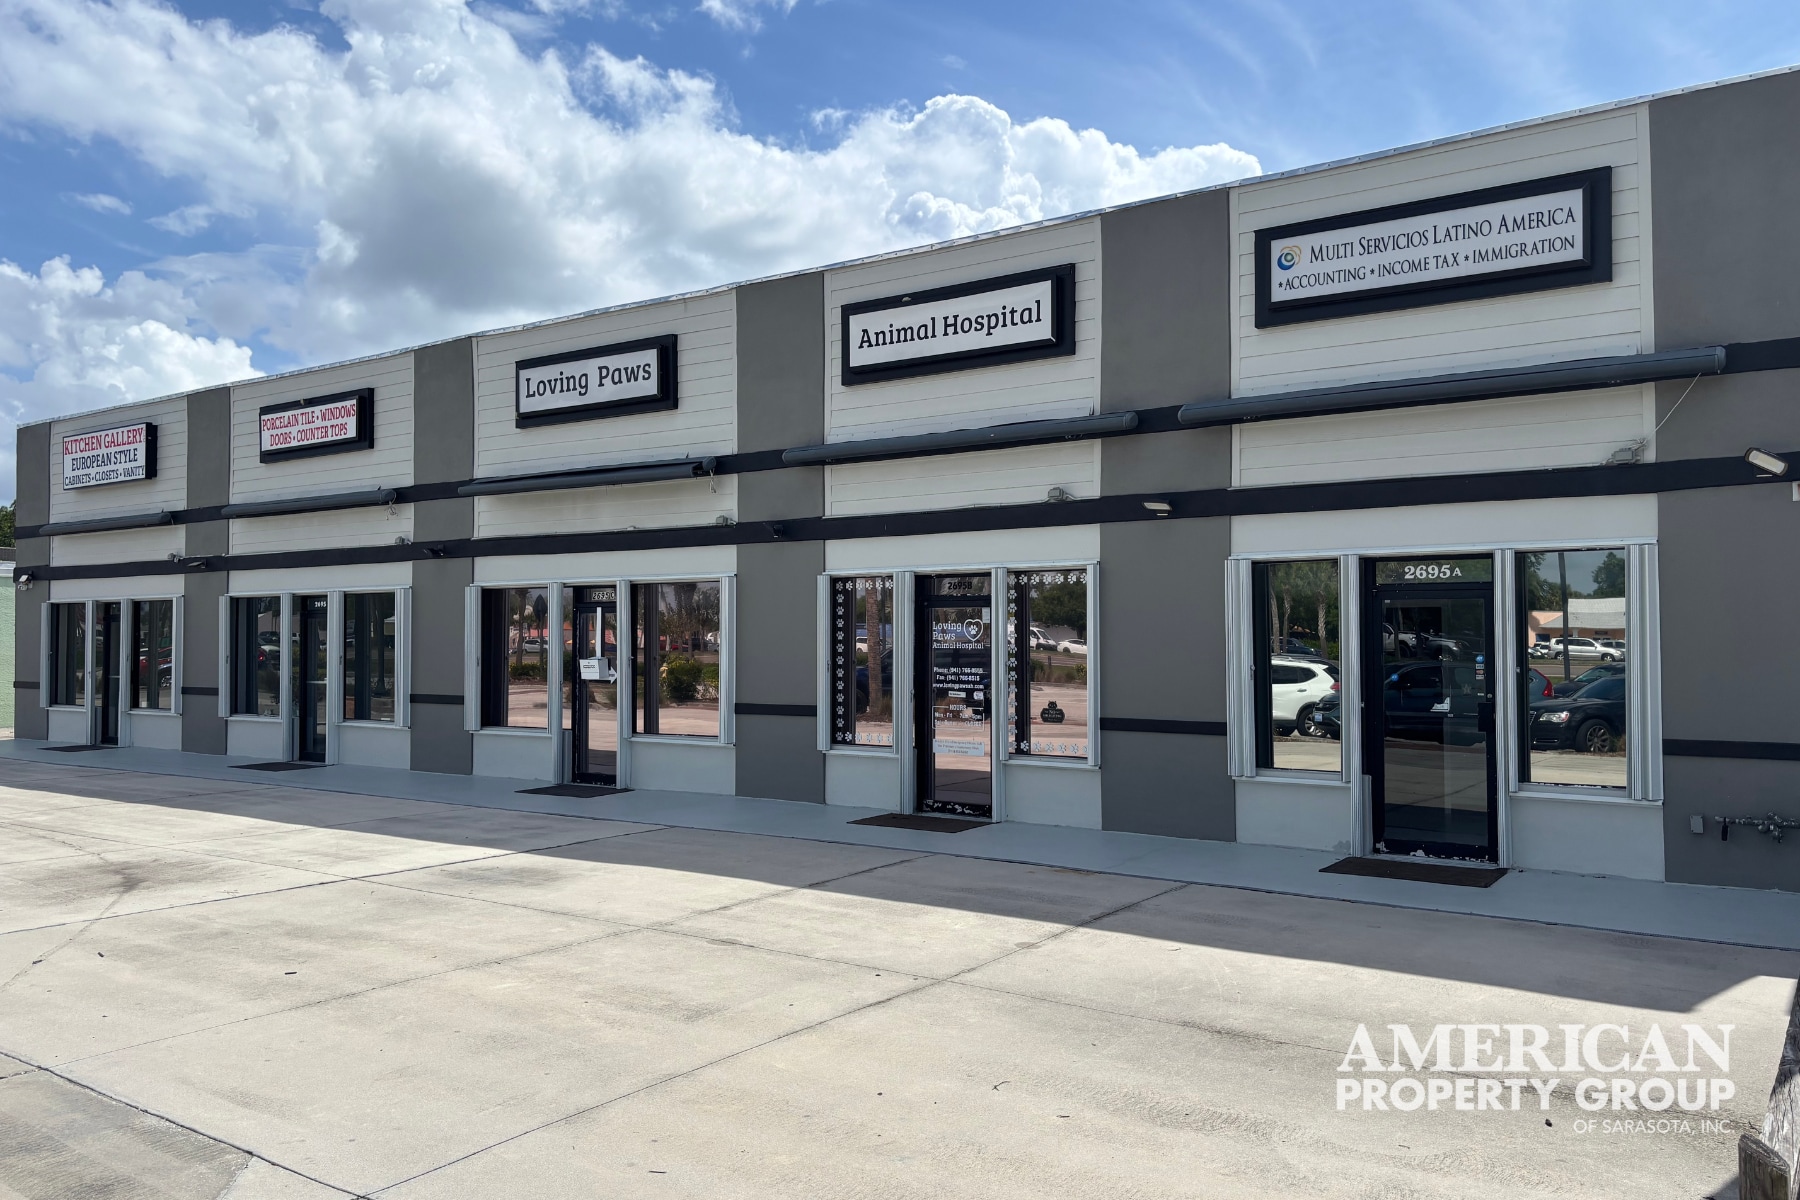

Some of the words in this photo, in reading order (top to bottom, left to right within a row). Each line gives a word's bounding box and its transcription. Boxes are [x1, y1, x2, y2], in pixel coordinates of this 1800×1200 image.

[1309, 241, 1355, 264] MULTI
[1358, 228, 1430, 257] SERVICIOS
[1432, 218, 1493, 245] LATINO
[1496, 206, 1577, 235] AMERICA
[1432, 251, 1460, 269] TAX
[858, 316, 937, 350] Animal
[942, 299, 1042, 337] Hospital
[525, 370, 589, 397] Loving
[597, 362, 652, 388] Paws
[262, 413, 300, 432] PORCELAIN
[300, 410, 316, 426] TILE
[320, 403, 356, 422] WINDOWS
[64, 434, 102, 455] KITCHEN
[103, 427, 144, 449] GALLERY
[270, 431, 292, 447] DOORS
[296, 426, 329, 443] COUNTER
[330, 422, 348, 437] TOPS
[71, 451, 112, 472] EUROPEAN
[113, 448, 138, 465] STYLE
[64, 472, 92, 487] CABINETS
[94, 468, 119, 482] CLOSETS
[122, 465, 145, 478] VANITY
[947, 581, 973, 590] 2695B
[932, 621, 962, 632] Loving
[932, 631, 956, 641] Paws
[932, 641, 956, 649] Animal
[956, 642, 984, 650] Hospital
